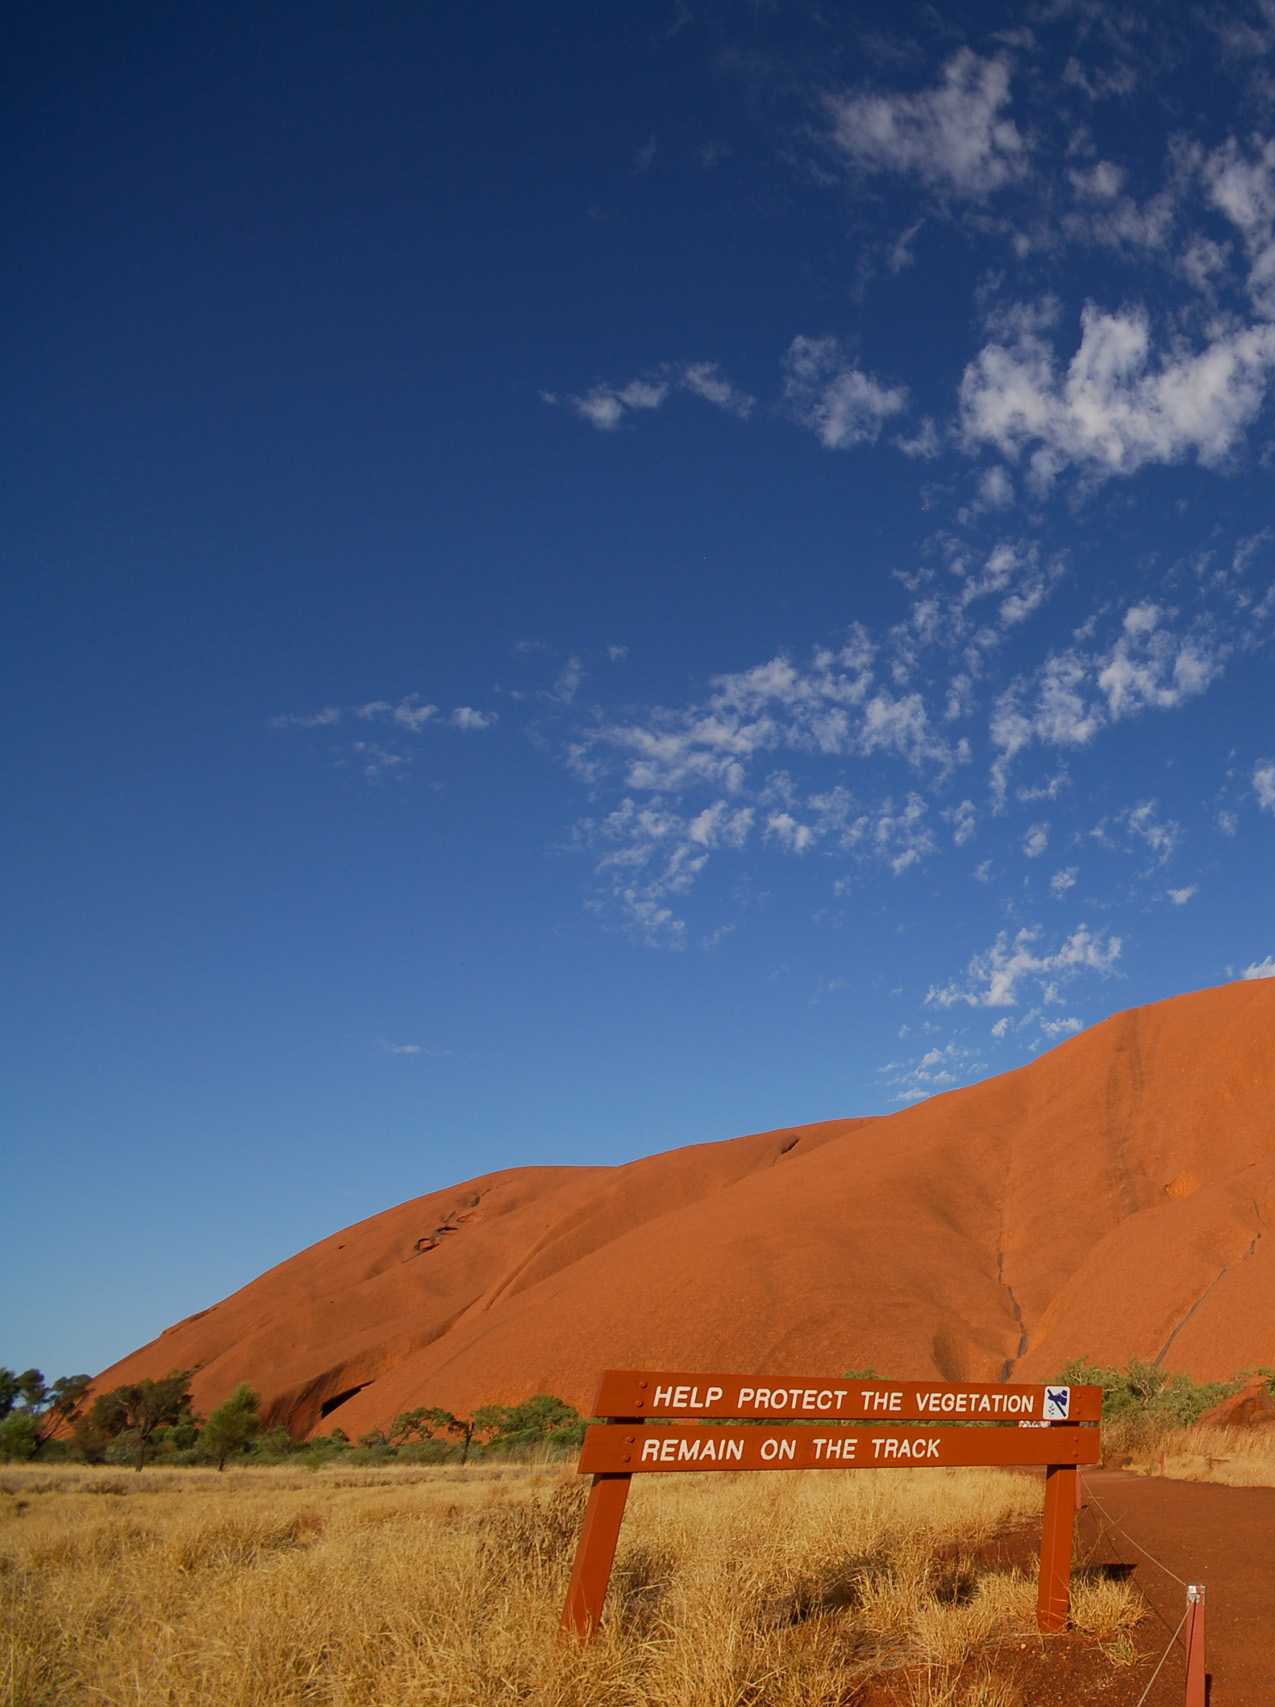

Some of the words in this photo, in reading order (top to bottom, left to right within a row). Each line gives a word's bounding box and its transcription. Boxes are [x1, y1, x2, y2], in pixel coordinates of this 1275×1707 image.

[652, 1385, 723, 1408] HELP
[737, 1388, 848, 1410] PROTECT
[861, 1391, 903, 1411] THE
[915, 1393, 1035, 1413] VEGETATION
[641, 1439, 745, 1461] REMAIN
[760, 1439, 797, 1461] ON
[812, 1438, 858, 1460] THE
[871, 1438, 941, 1459] TRACK
